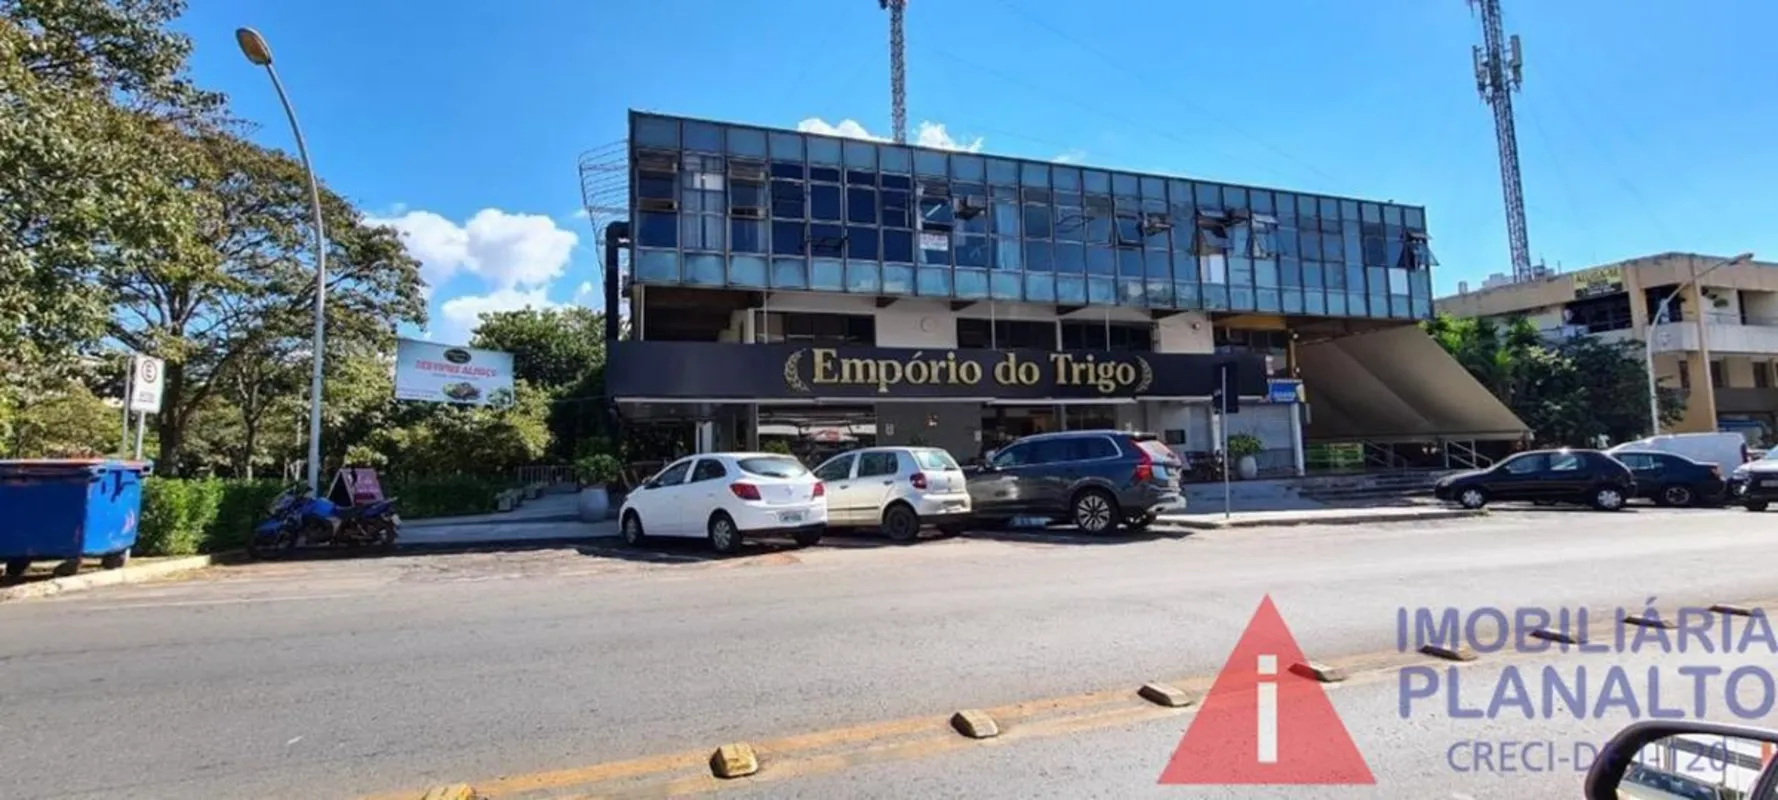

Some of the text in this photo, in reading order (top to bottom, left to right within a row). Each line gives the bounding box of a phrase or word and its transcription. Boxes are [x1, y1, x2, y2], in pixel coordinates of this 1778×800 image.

[812, 348, 1136, 393] Empório do Trigo
